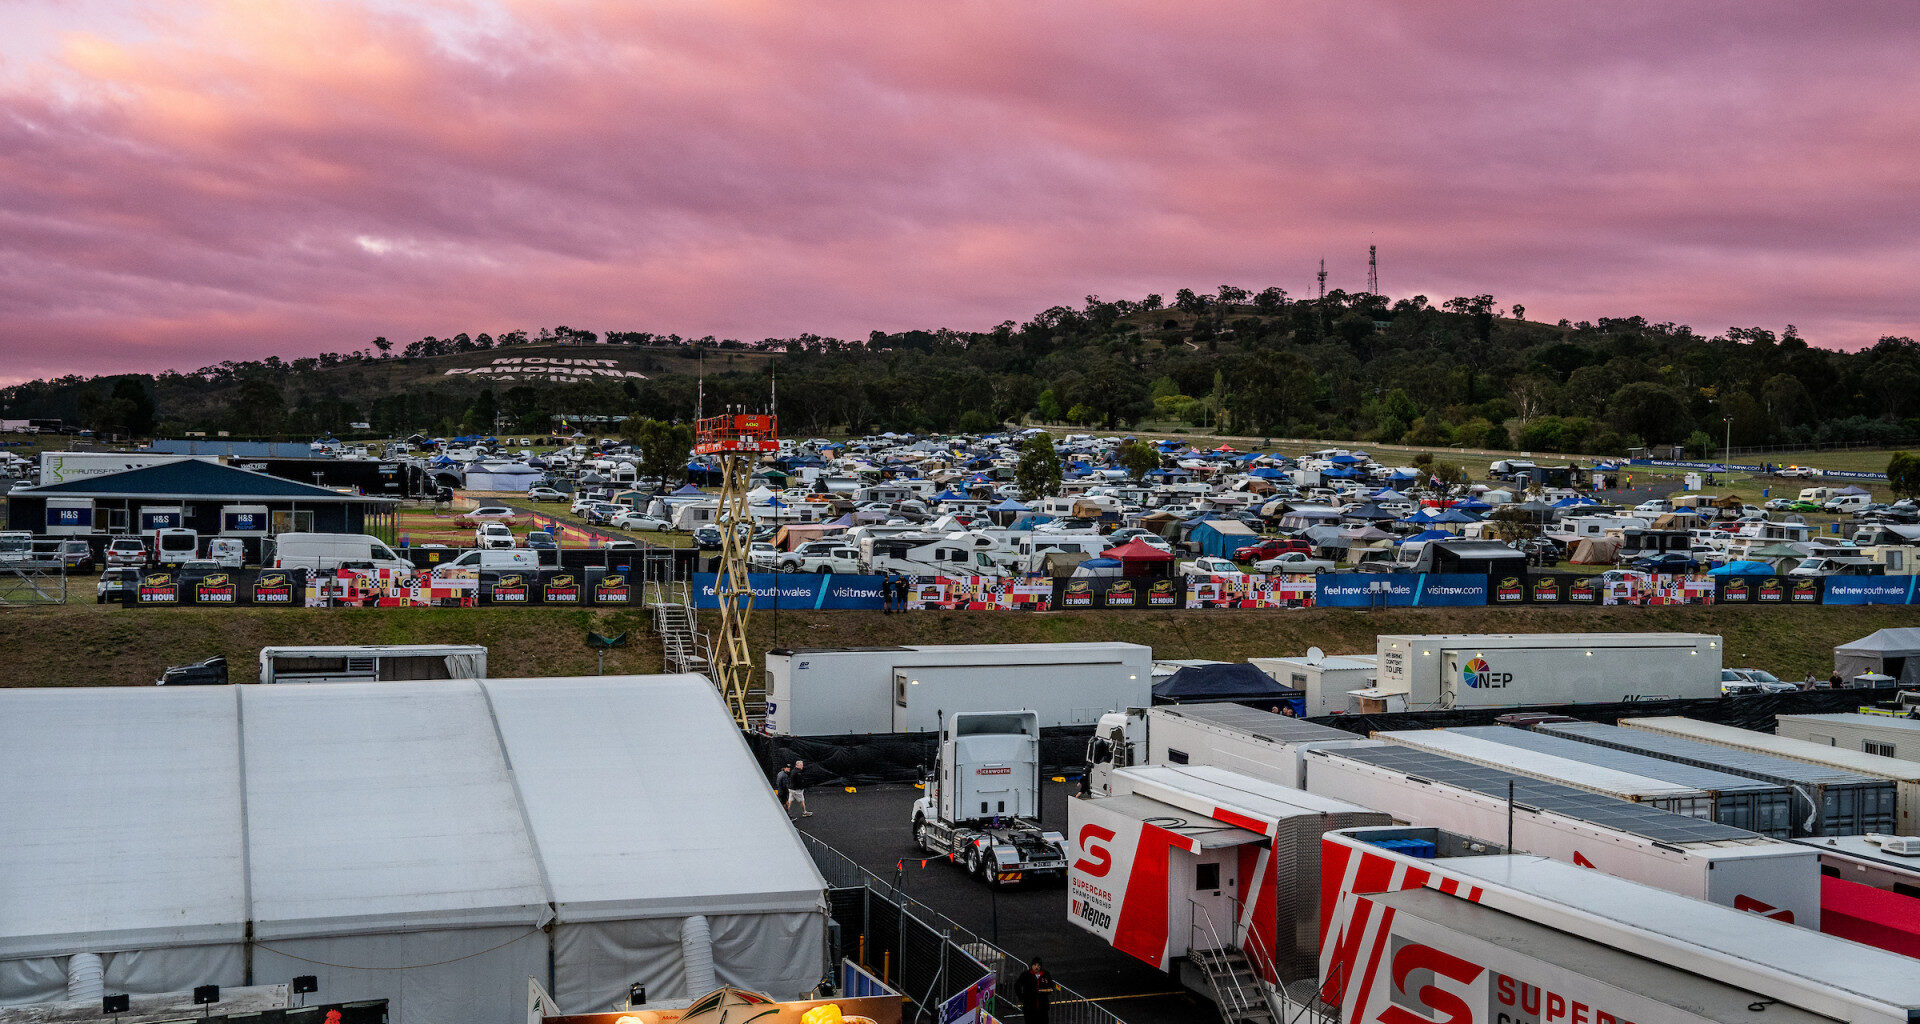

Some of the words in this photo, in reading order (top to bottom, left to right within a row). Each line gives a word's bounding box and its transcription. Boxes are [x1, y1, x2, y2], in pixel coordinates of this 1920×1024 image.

[492, 357, 619, 368] MOUNT
[444, 366, 650, 380] PANORAMA
[60, 510, 78, 519] H&S
[153, 515, 169, 523] H&S
[238, 514, 253, 522] H&S
[782, 586, 811, 597] wales
[1324, 585, 1341, 595] feel
[1427, 585, 1483, 595] visitnsw.com
[1831, 586, 1846, 594] feel
[1864, 586, 1883, 595] south
[1884, 586, 1904, 595] wales
[1386, 665, 1392, 673] TO
[1393, 666, 1402, 675] LIFE
[1479, 672, 1513, 688] NEP
[1826, 796, 1832, 806] 2
[1073, 877, 1112, 902] SUPERCARS
[1072, 887, 1112, 910] CHAMPIONSHIP
[1080, 899, 1111, 930] Repco
